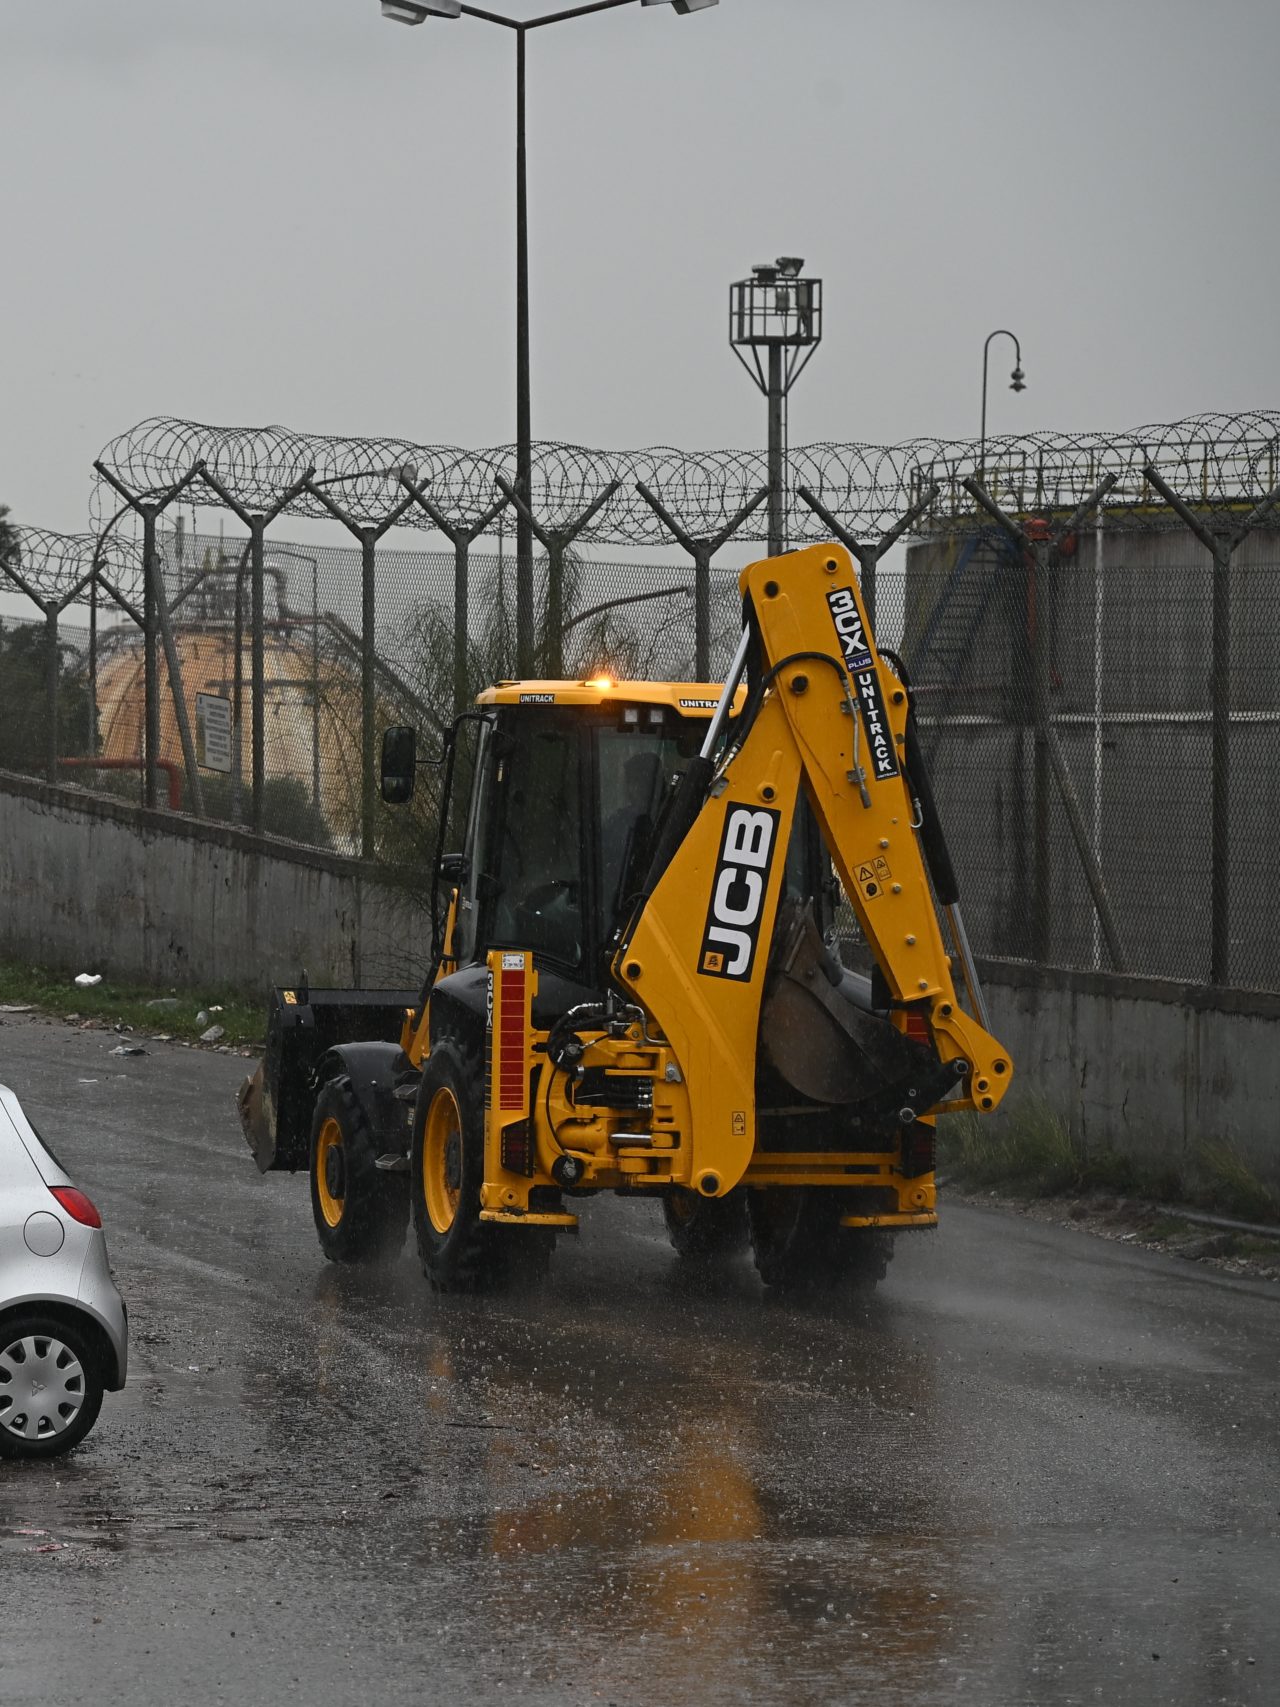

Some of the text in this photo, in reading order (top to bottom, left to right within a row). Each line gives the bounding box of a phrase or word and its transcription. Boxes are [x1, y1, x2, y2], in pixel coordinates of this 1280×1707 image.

[829, 590, 868, 656] 3CX
[847, 658, 872, 670] PLUS
[520, 694, 554, 703] UNITRACK
[680, 699, 720, 709] UNITRA
[858, 673, 893, 772] UNITRACK
[708, 809, 774, 976] JCB
[486, 972, 494, 1027] 3CX
